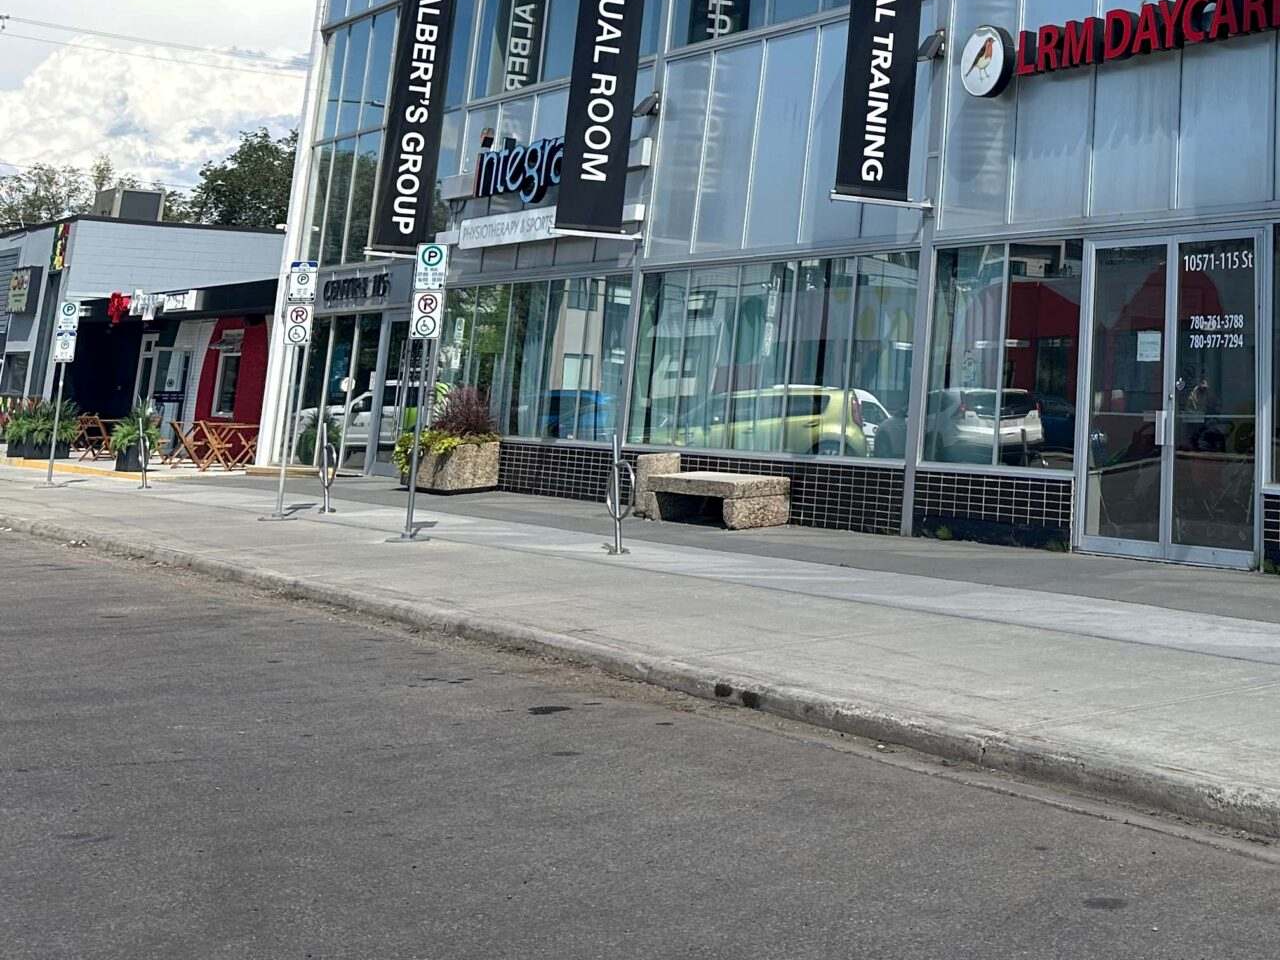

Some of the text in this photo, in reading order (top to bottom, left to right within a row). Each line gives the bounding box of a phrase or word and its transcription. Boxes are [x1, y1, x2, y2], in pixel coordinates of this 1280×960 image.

[1016, 17, 1097, 76] LRM
[580, 72, 618, 182] ROOM
[860, 33, 895, 182] TRAINING
[391, 132, 425, 235] GROUP
[462, 220, 519, 242] PHYSIOTHERAPY
[526, 215, 554, 233] SPORTS
[1183, 250, 1254, 272] 10571-115 St
[1190, 314, 1244, 330] 780-761-3788
[1190, 334, 1244, 349] 780-977-7294
